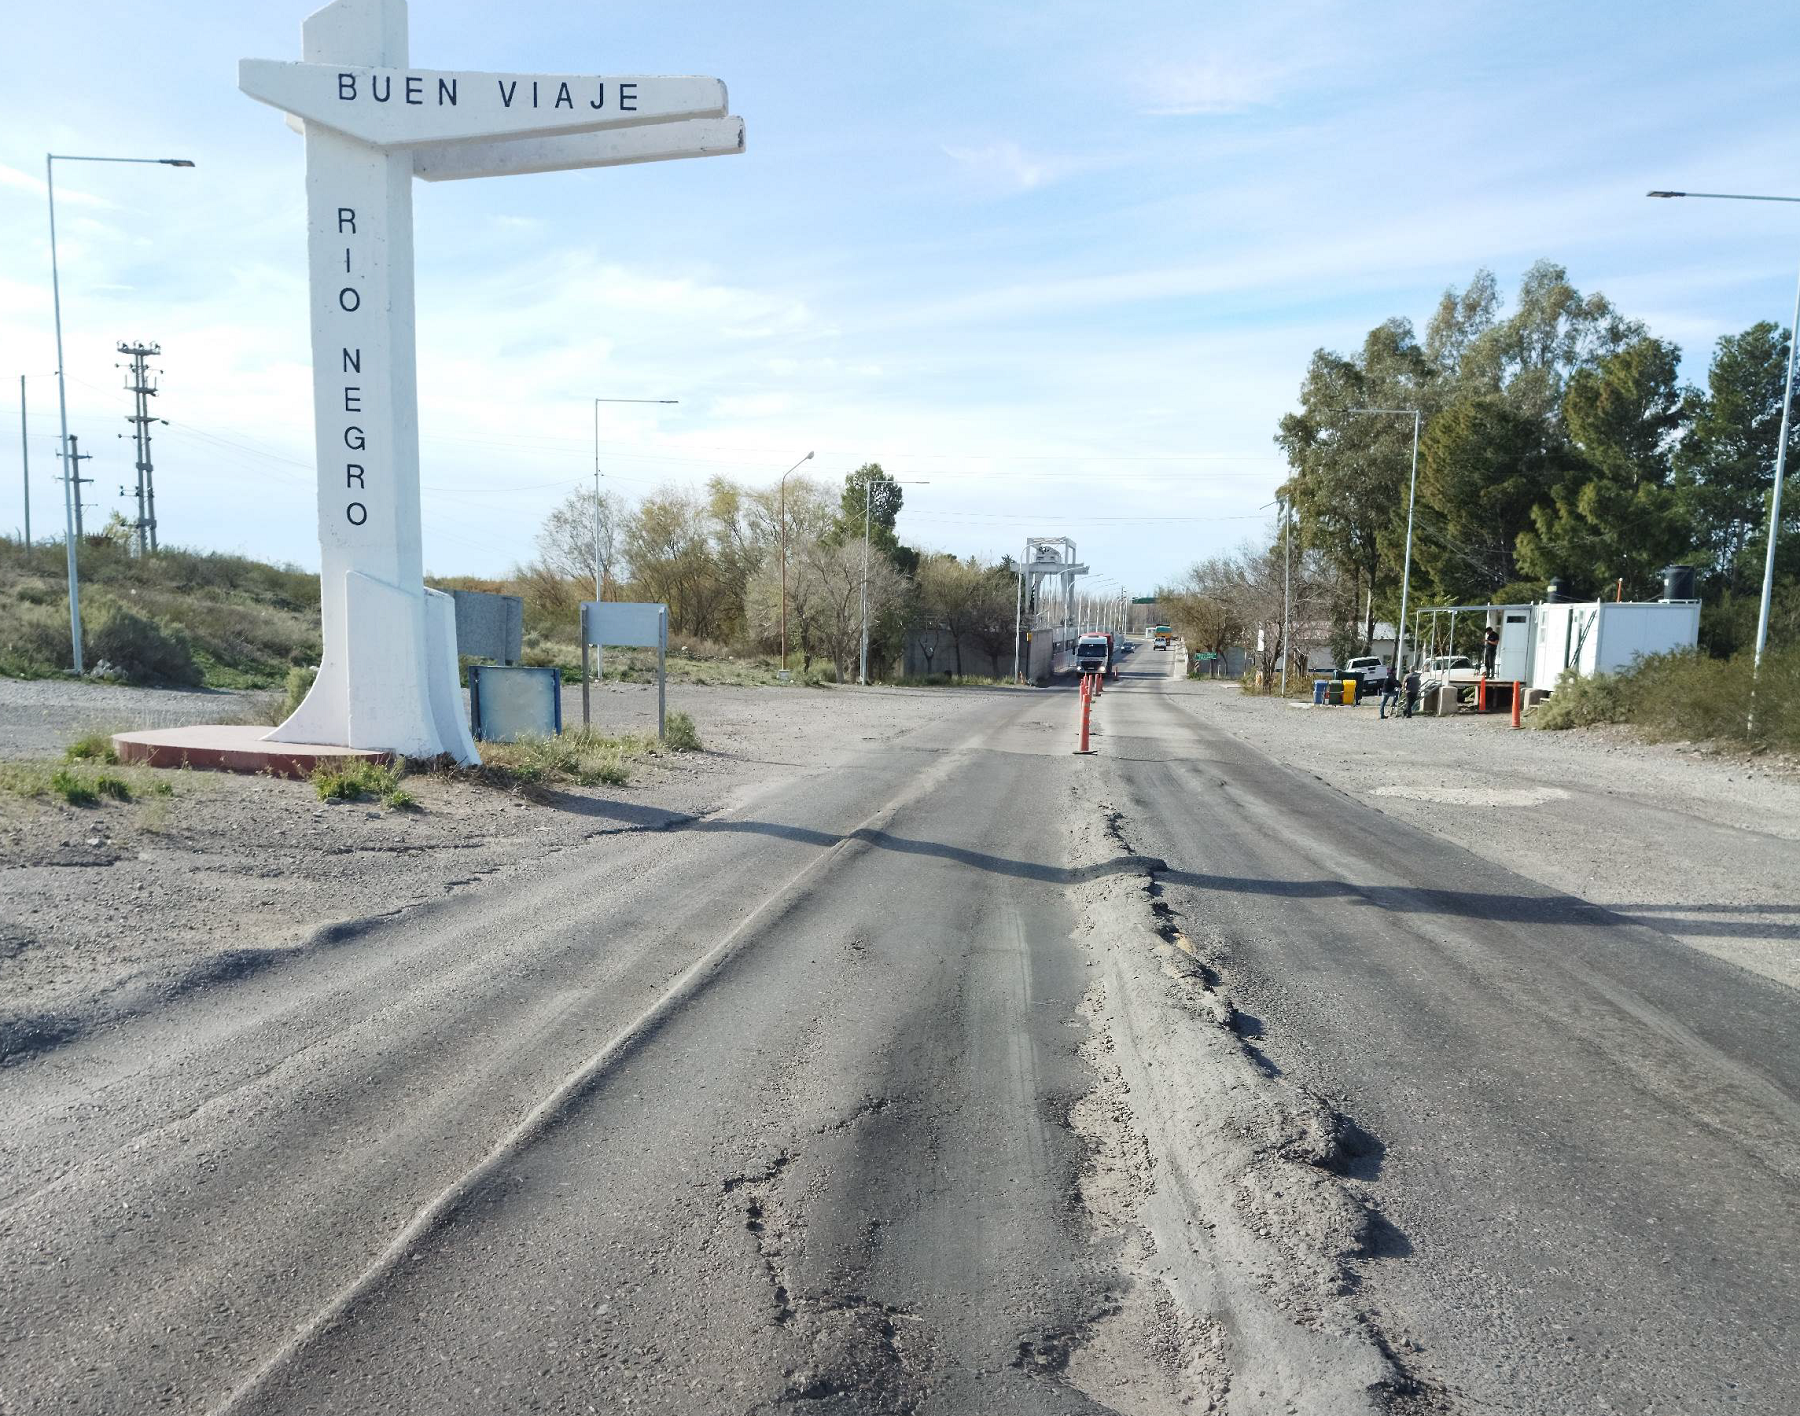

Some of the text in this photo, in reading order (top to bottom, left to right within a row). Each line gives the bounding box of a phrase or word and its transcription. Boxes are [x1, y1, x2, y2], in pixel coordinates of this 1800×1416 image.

[337, 72, 637, 111] BUEN VIAJE
[337, 207, 368, 526] RIO NEGRO
